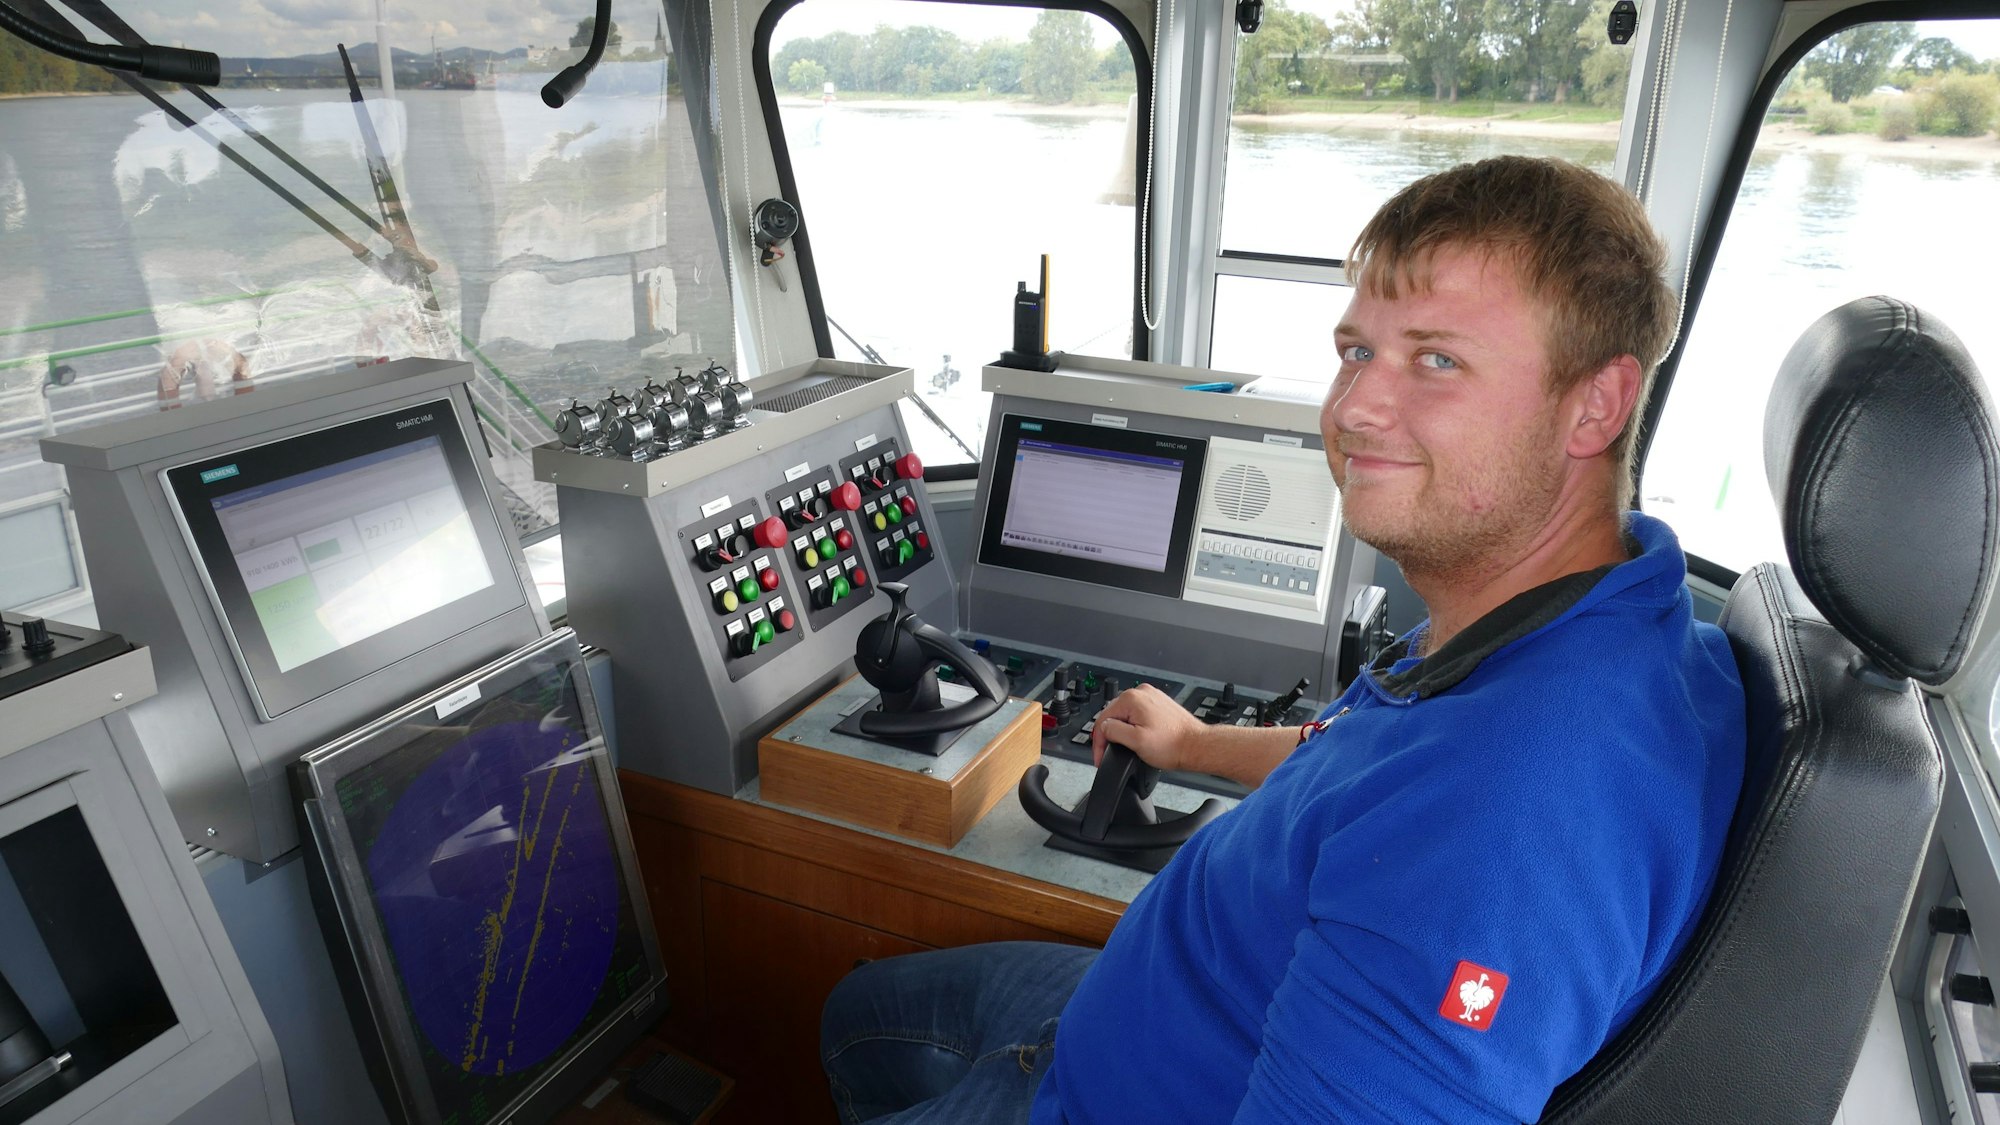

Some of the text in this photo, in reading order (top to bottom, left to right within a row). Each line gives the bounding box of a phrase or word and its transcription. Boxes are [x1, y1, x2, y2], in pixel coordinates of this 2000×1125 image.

[396, 413, 434, 430] SIMATIC HMI
[1155, 440, 1176, 449] SIMATIC
[203, 466, 237, 481] SIEMENS
